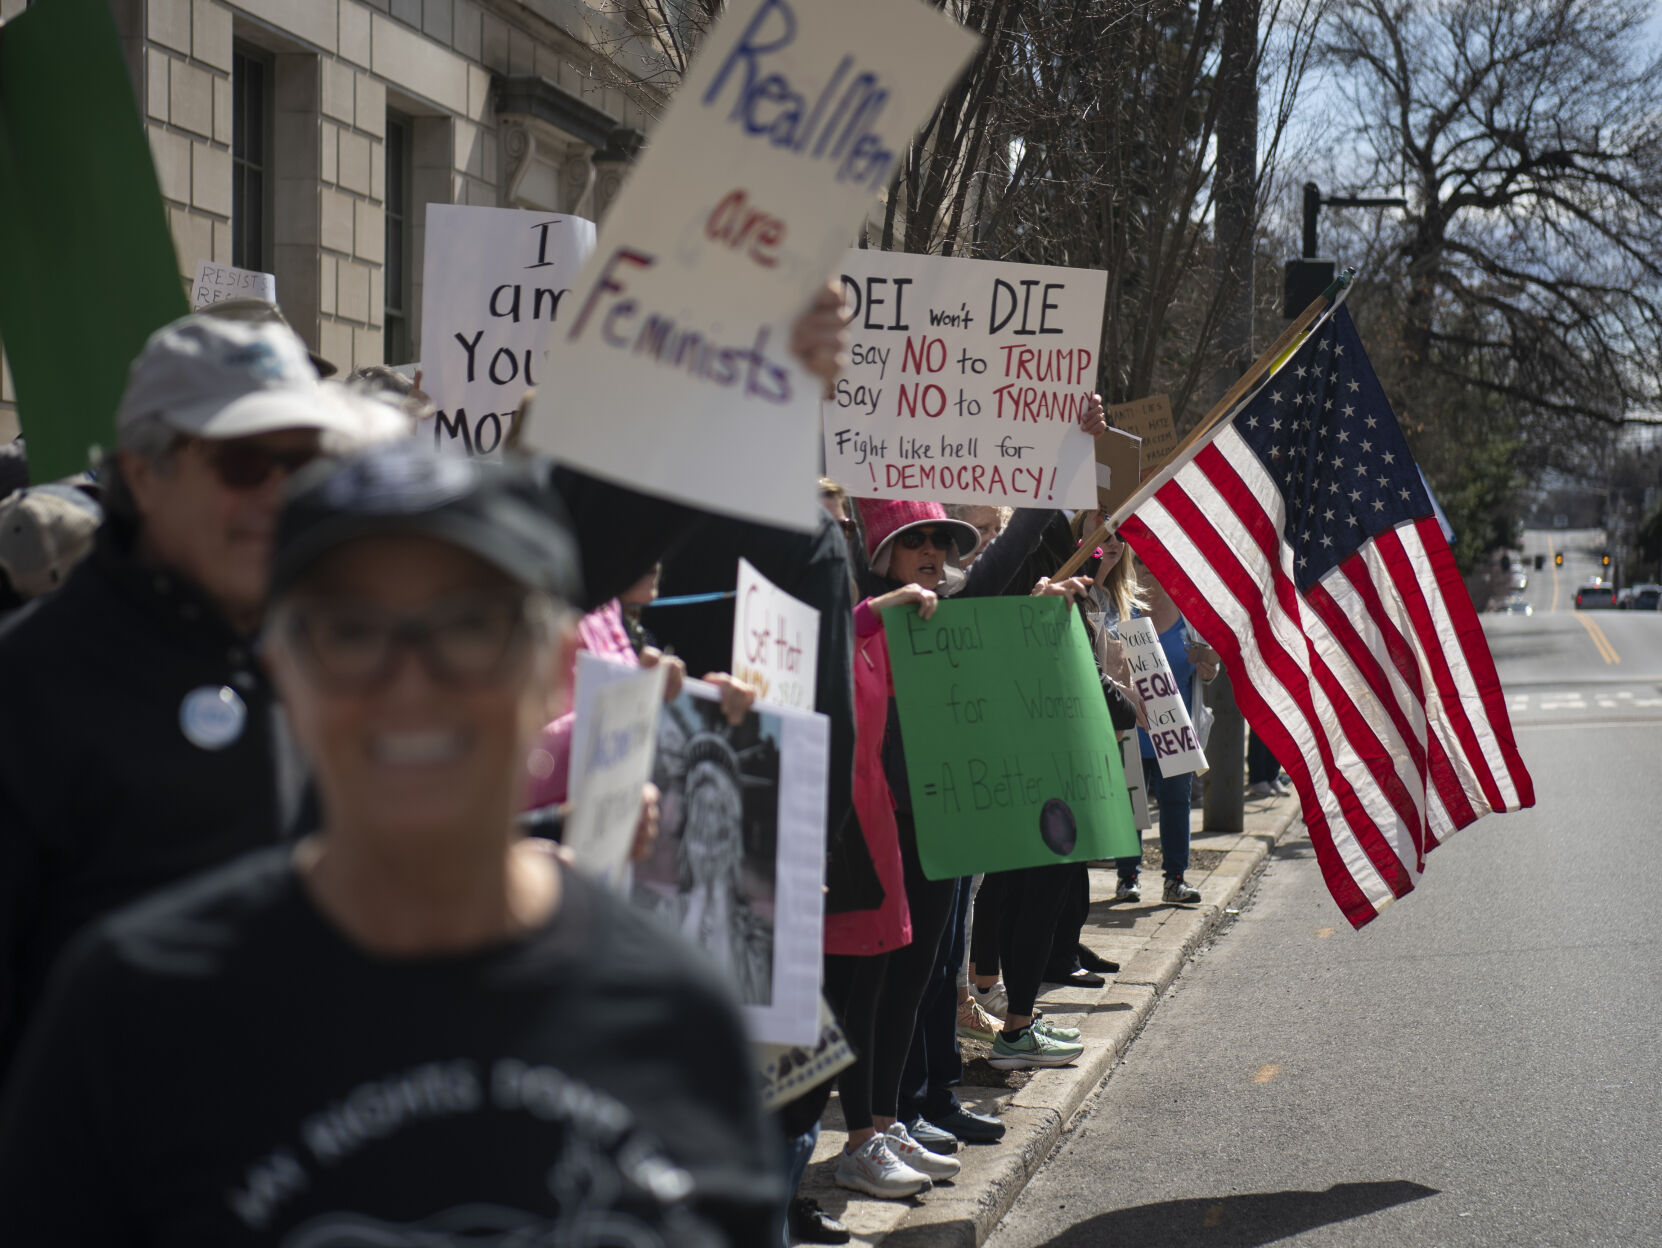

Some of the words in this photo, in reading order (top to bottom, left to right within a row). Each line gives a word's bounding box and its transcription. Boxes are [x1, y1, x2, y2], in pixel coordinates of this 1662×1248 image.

[524, 219, 562, 269] I
[703, 187, 790, 268] are
[201, 266, 259, 289] RESIST
[565, 246, 796, 407] Feminists
[840, 274, 913, 331] DEI
[988, 278, 1066, 336] DIE
[901, 335, 947, 376] NO
[956, 347, 988, 375] to
[999, 344, 1092, 386] TRUMP
[896, 382, 947, 418] NO
[953, 388, 982, 417] to
[834, 429, 888, 465] Fight
[899, 436, 938, 459] like
[941, 434, 978, 459] hell
[995, 436, 1035, 459] for
[906, 608, 983, 668] Equal
[946, 683, 988, 724] for
[1014, 679, 1086, 720] Women
[1146, 707, 1177, 730] NOT
[967, 757, 1043, 811] Better
